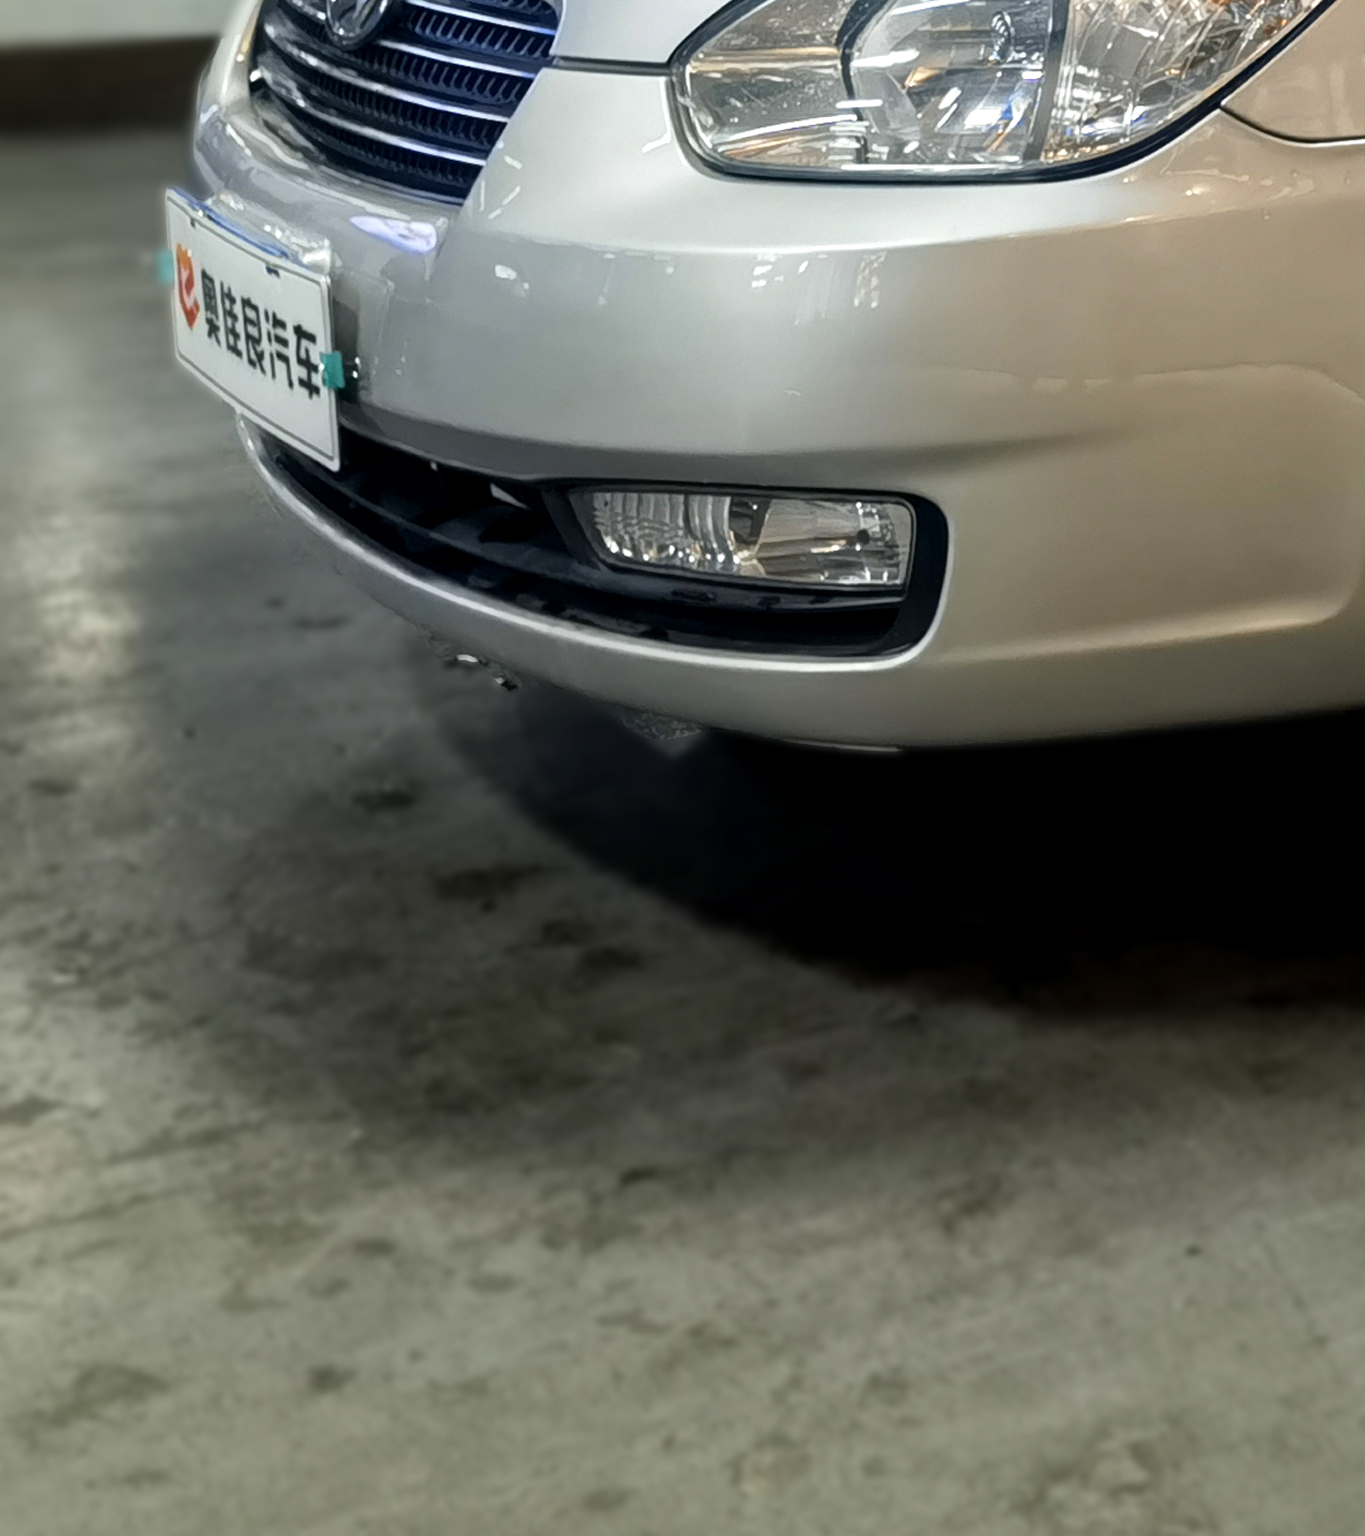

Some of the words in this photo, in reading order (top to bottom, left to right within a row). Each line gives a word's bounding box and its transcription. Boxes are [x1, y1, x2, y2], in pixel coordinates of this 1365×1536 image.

[201, 268, 321, 400] 奥佳良汽车
